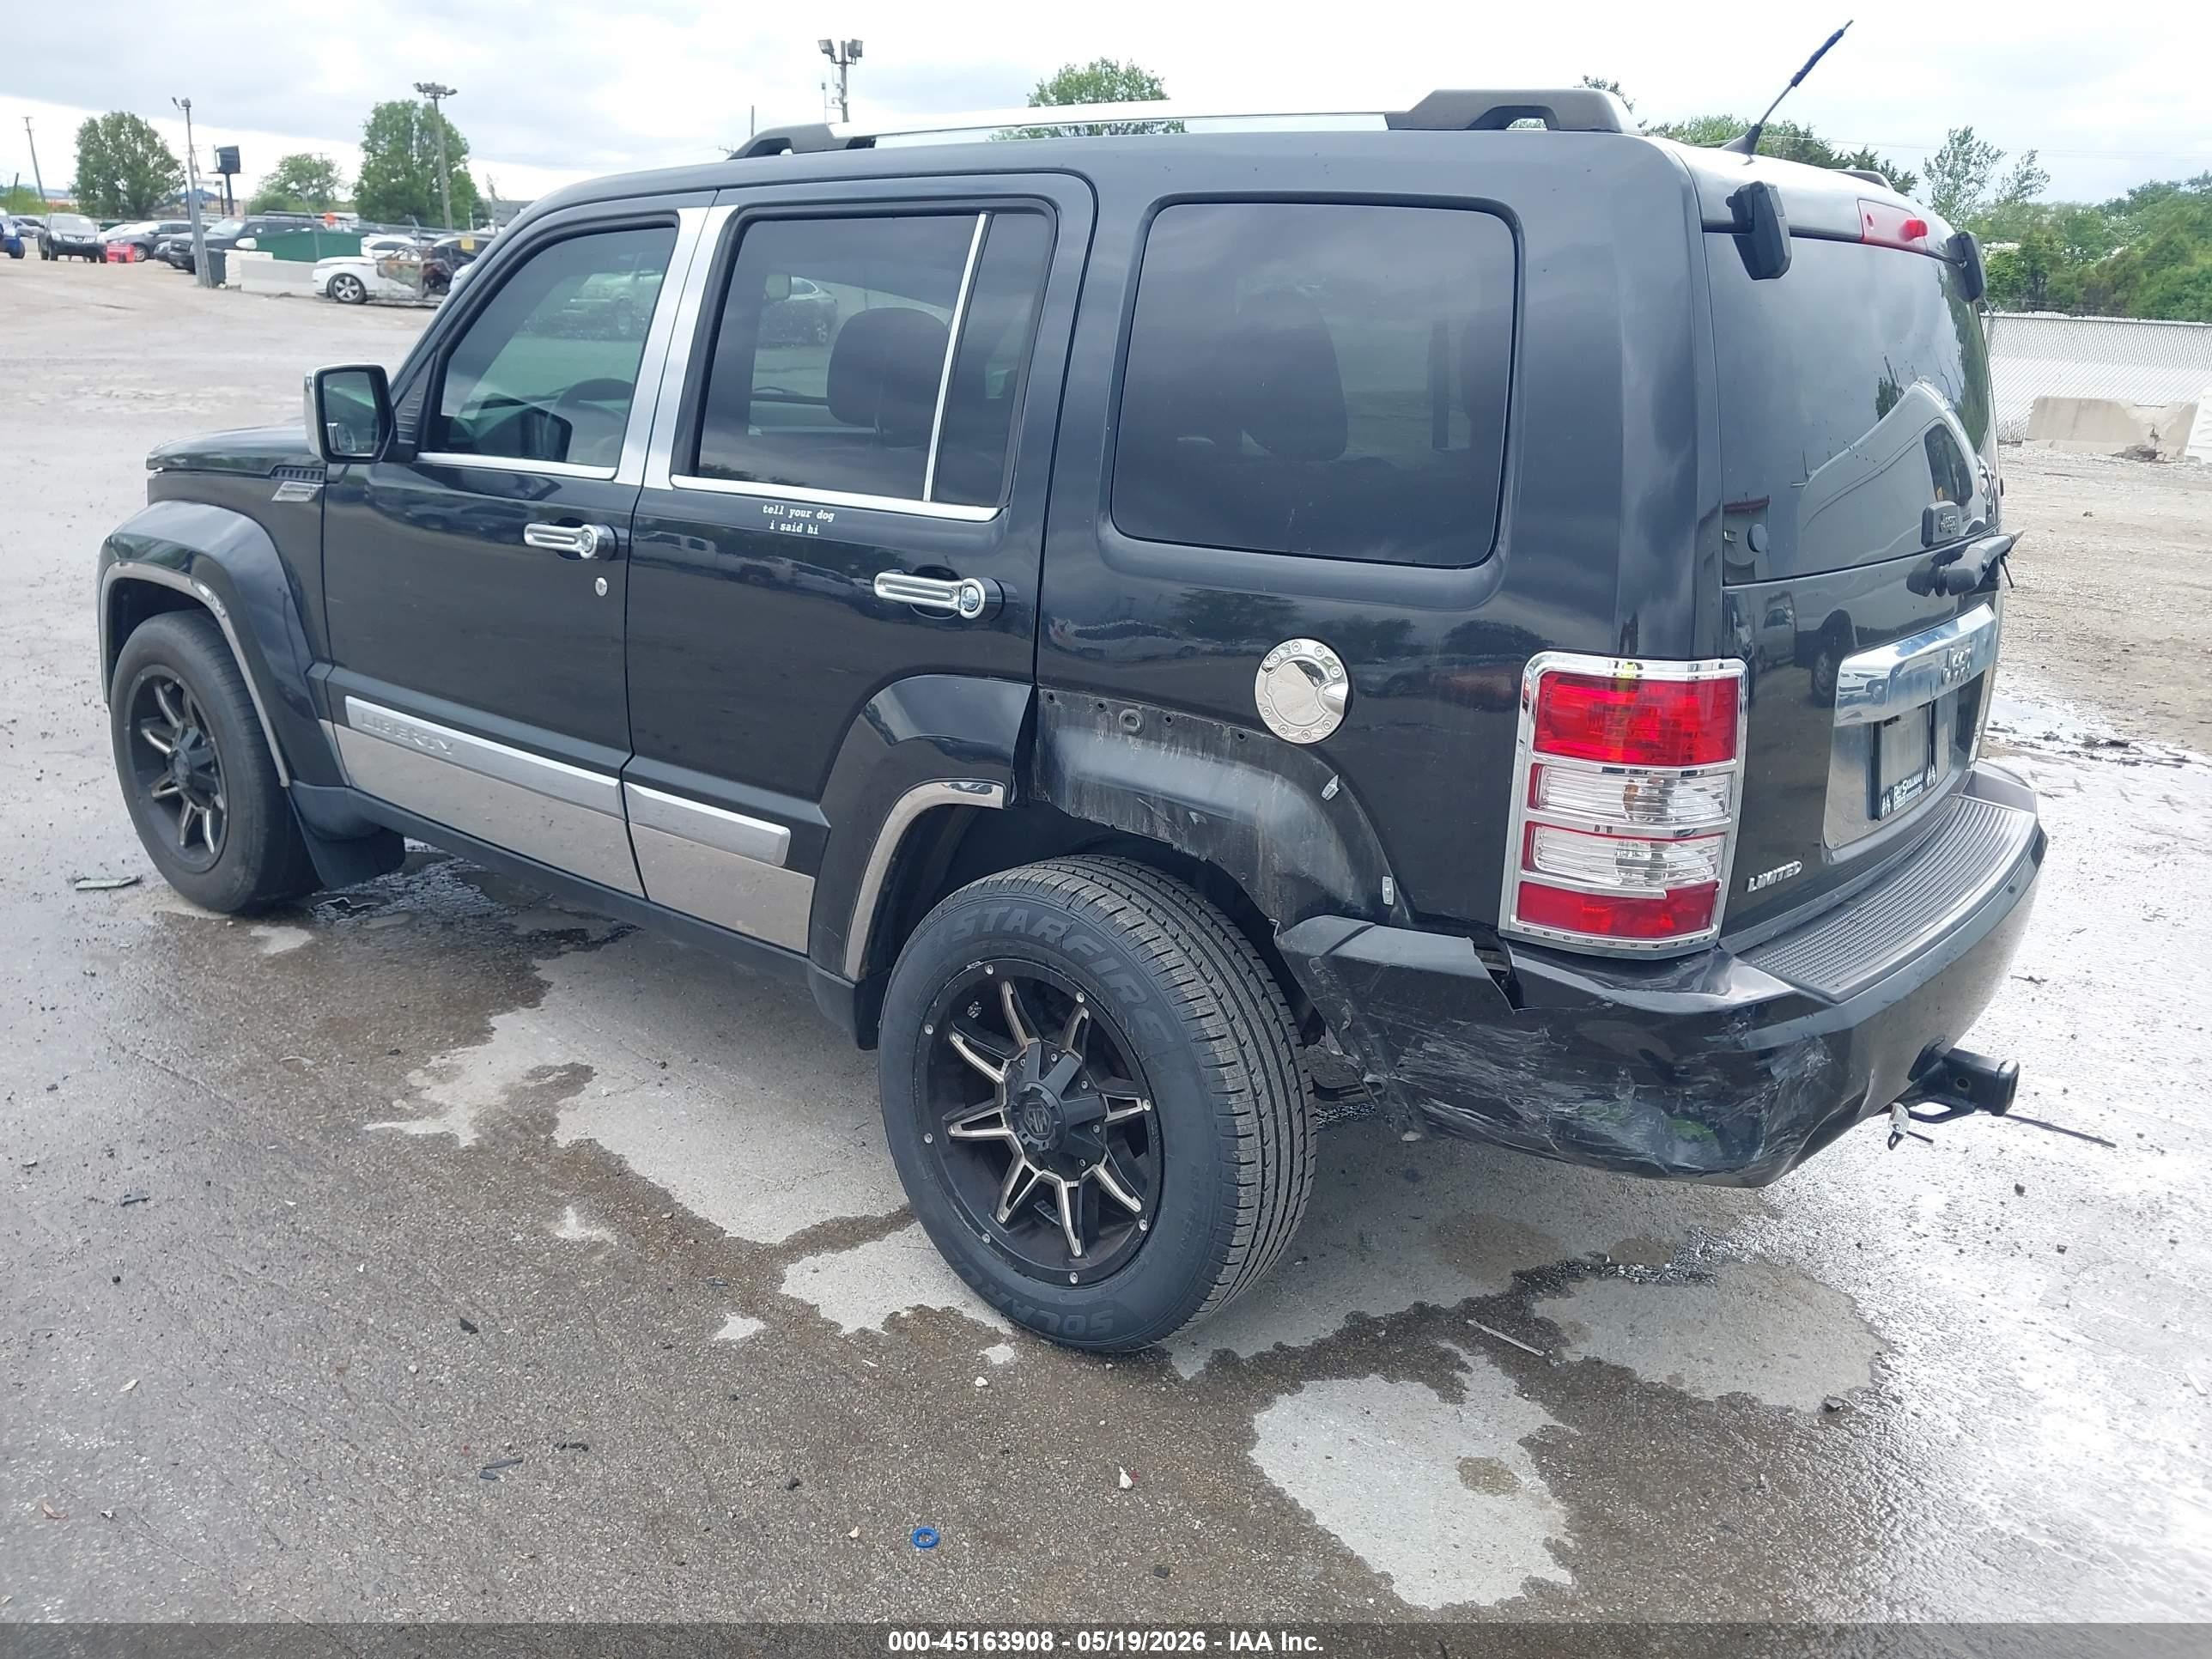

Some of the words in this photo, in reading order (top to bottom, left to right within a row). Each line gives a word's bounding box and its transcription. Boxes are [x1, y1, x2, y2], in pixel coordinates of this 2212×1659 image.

[763, 504, 784, 515] tell
[788, 507, 812, 519] your
[817, 509, 835, 522] dog
[769, 520, 775, 530] i
[780, 522, 803, 533] said
[807, 524, 819, 535] hi
[362, 713, 453, 755] LIBERTY
[951, 907, 1173, 1042] STARFIRE
